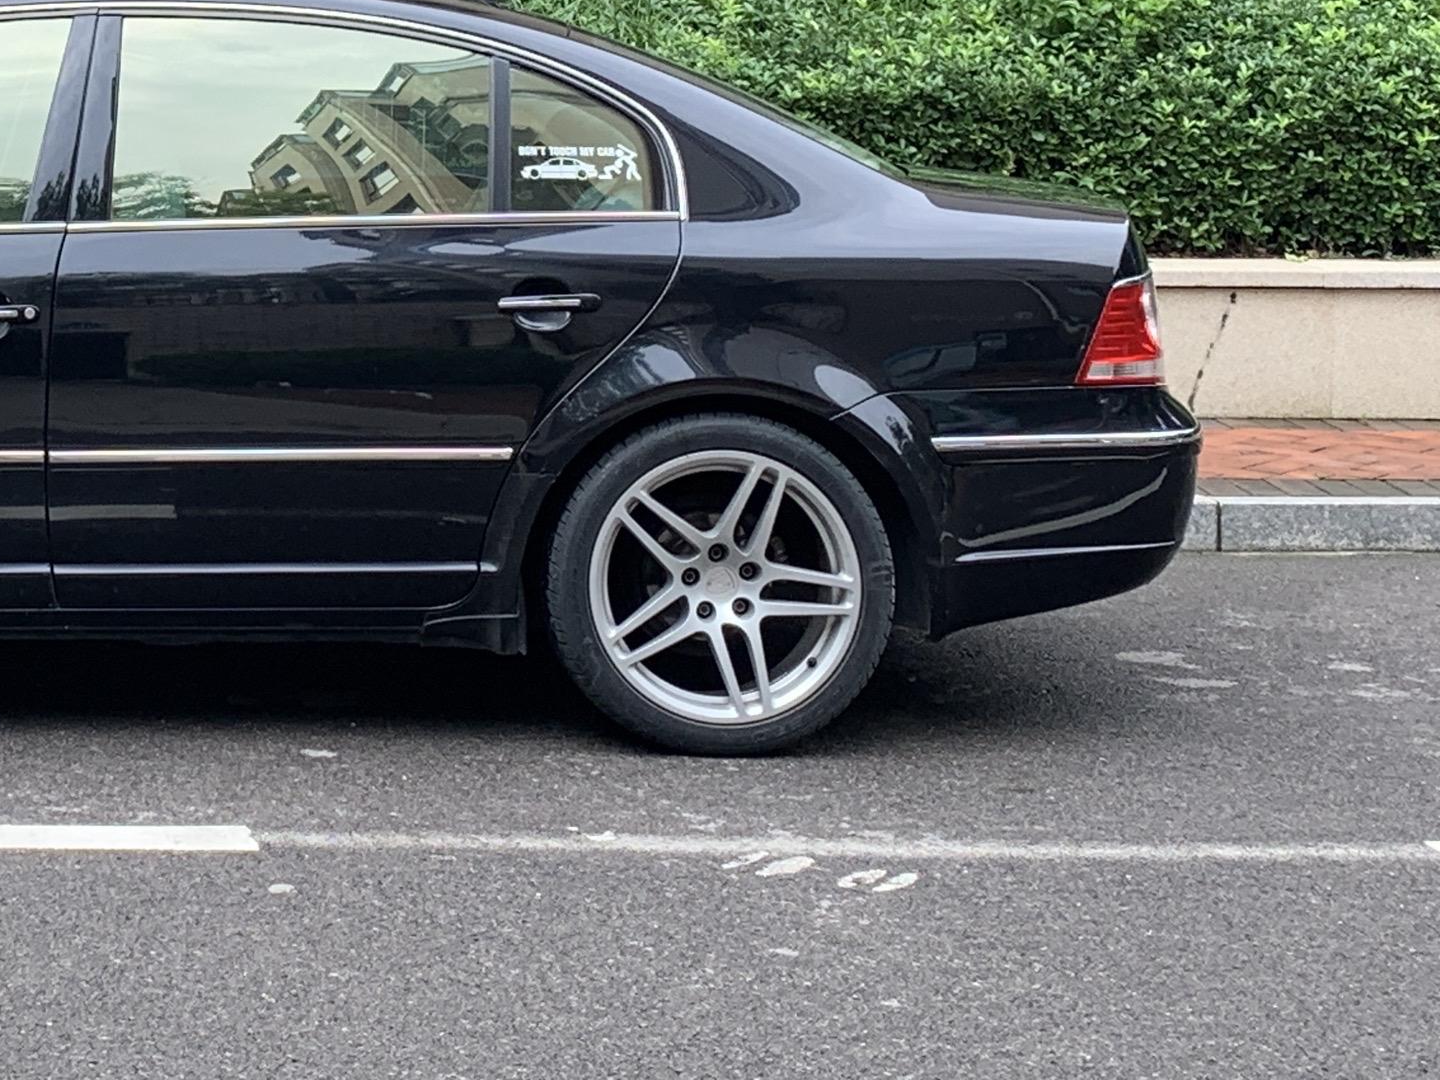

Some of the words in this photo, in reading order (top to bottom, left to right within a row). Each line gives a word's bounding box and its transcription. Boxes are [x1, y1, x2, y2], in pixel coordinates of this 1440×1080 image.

[549, 145, 577, 157] TOUCH
[579, 146, 595, 157] MY
[596, 146, 615, 157] CAR
